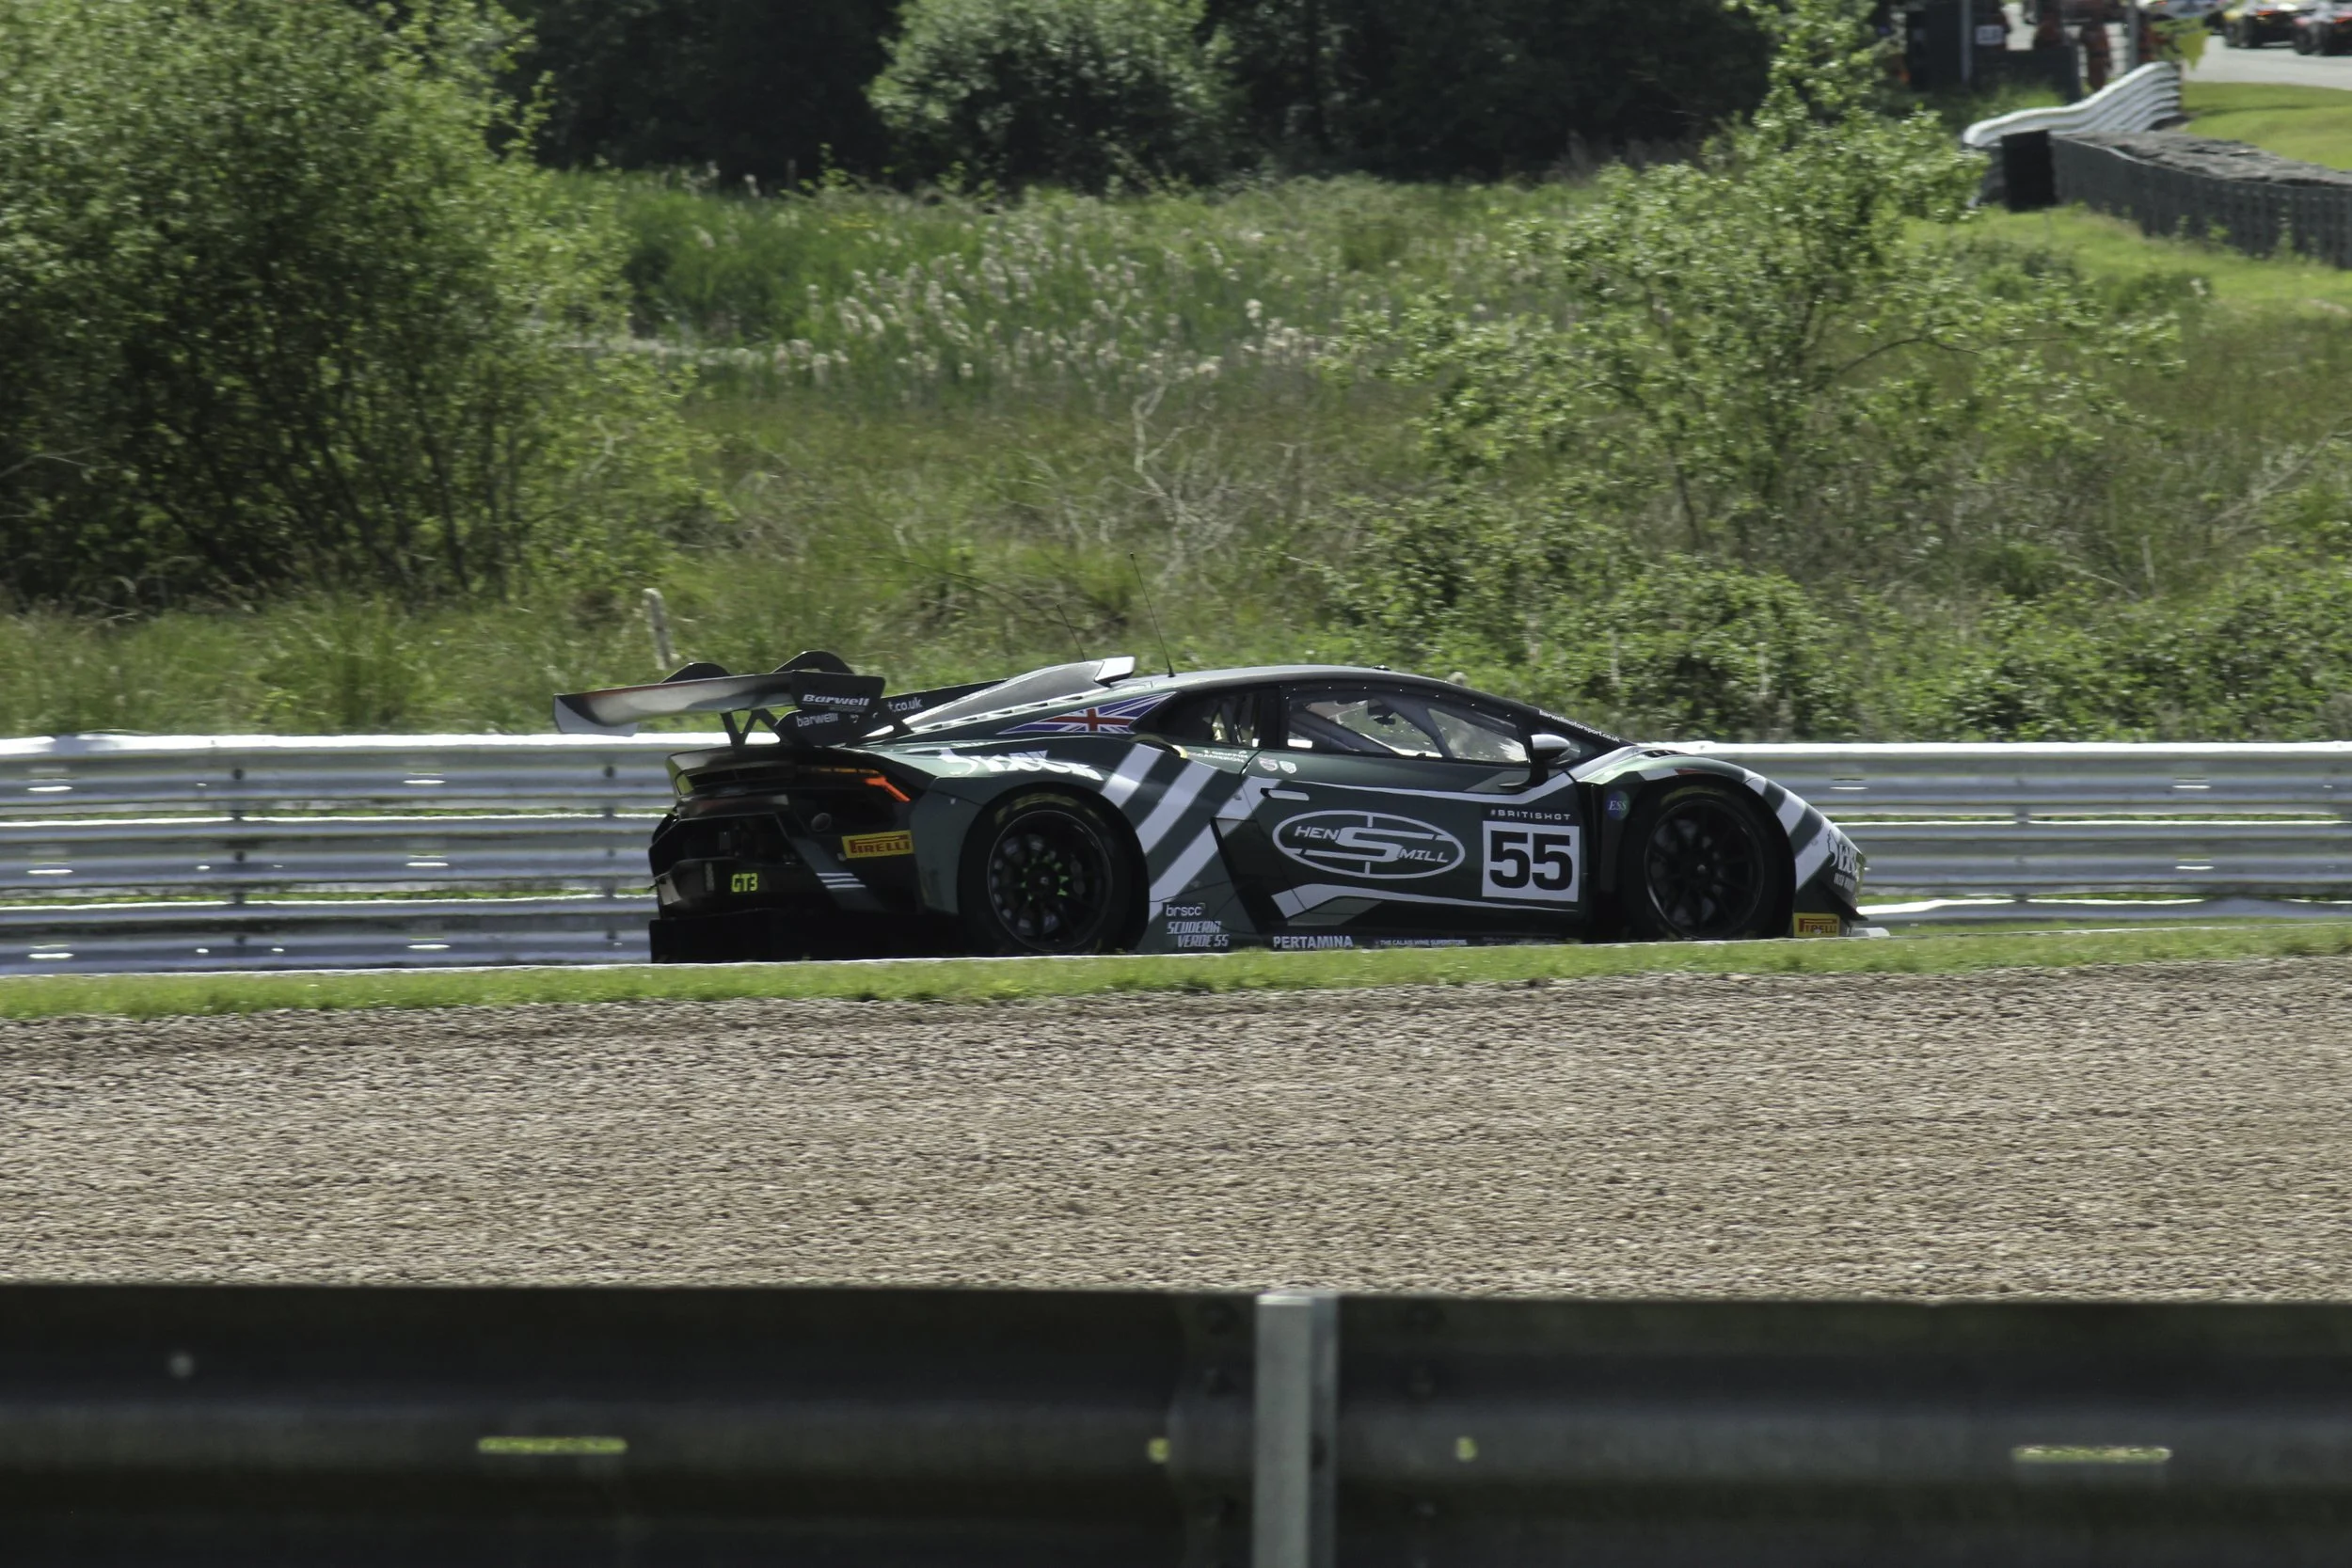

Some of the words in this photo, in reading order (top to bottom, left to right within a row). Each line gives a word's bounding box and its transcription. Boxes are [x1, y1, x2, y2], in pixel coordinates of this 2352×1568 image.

[802, 694, 870, 706] Barwell
[1608, 800, 1627, 811] ESS
[1490, 809, 1571, 820] #BRITISHGT
[849, 834, 910, 854] PIRELLI
[1489, 830, 1573, 891] 55
[731, 873, 757, 893] GT3
[1166, 904, 1202, 916] brscc
[1167, 921, 1222, 934] SCUDERIA
[1799, 918, 1837, 933] PIRELLI
[1177, 934, 1212, 948] VERDE
[1273, 935, 1354, 949] PERTAMINA
